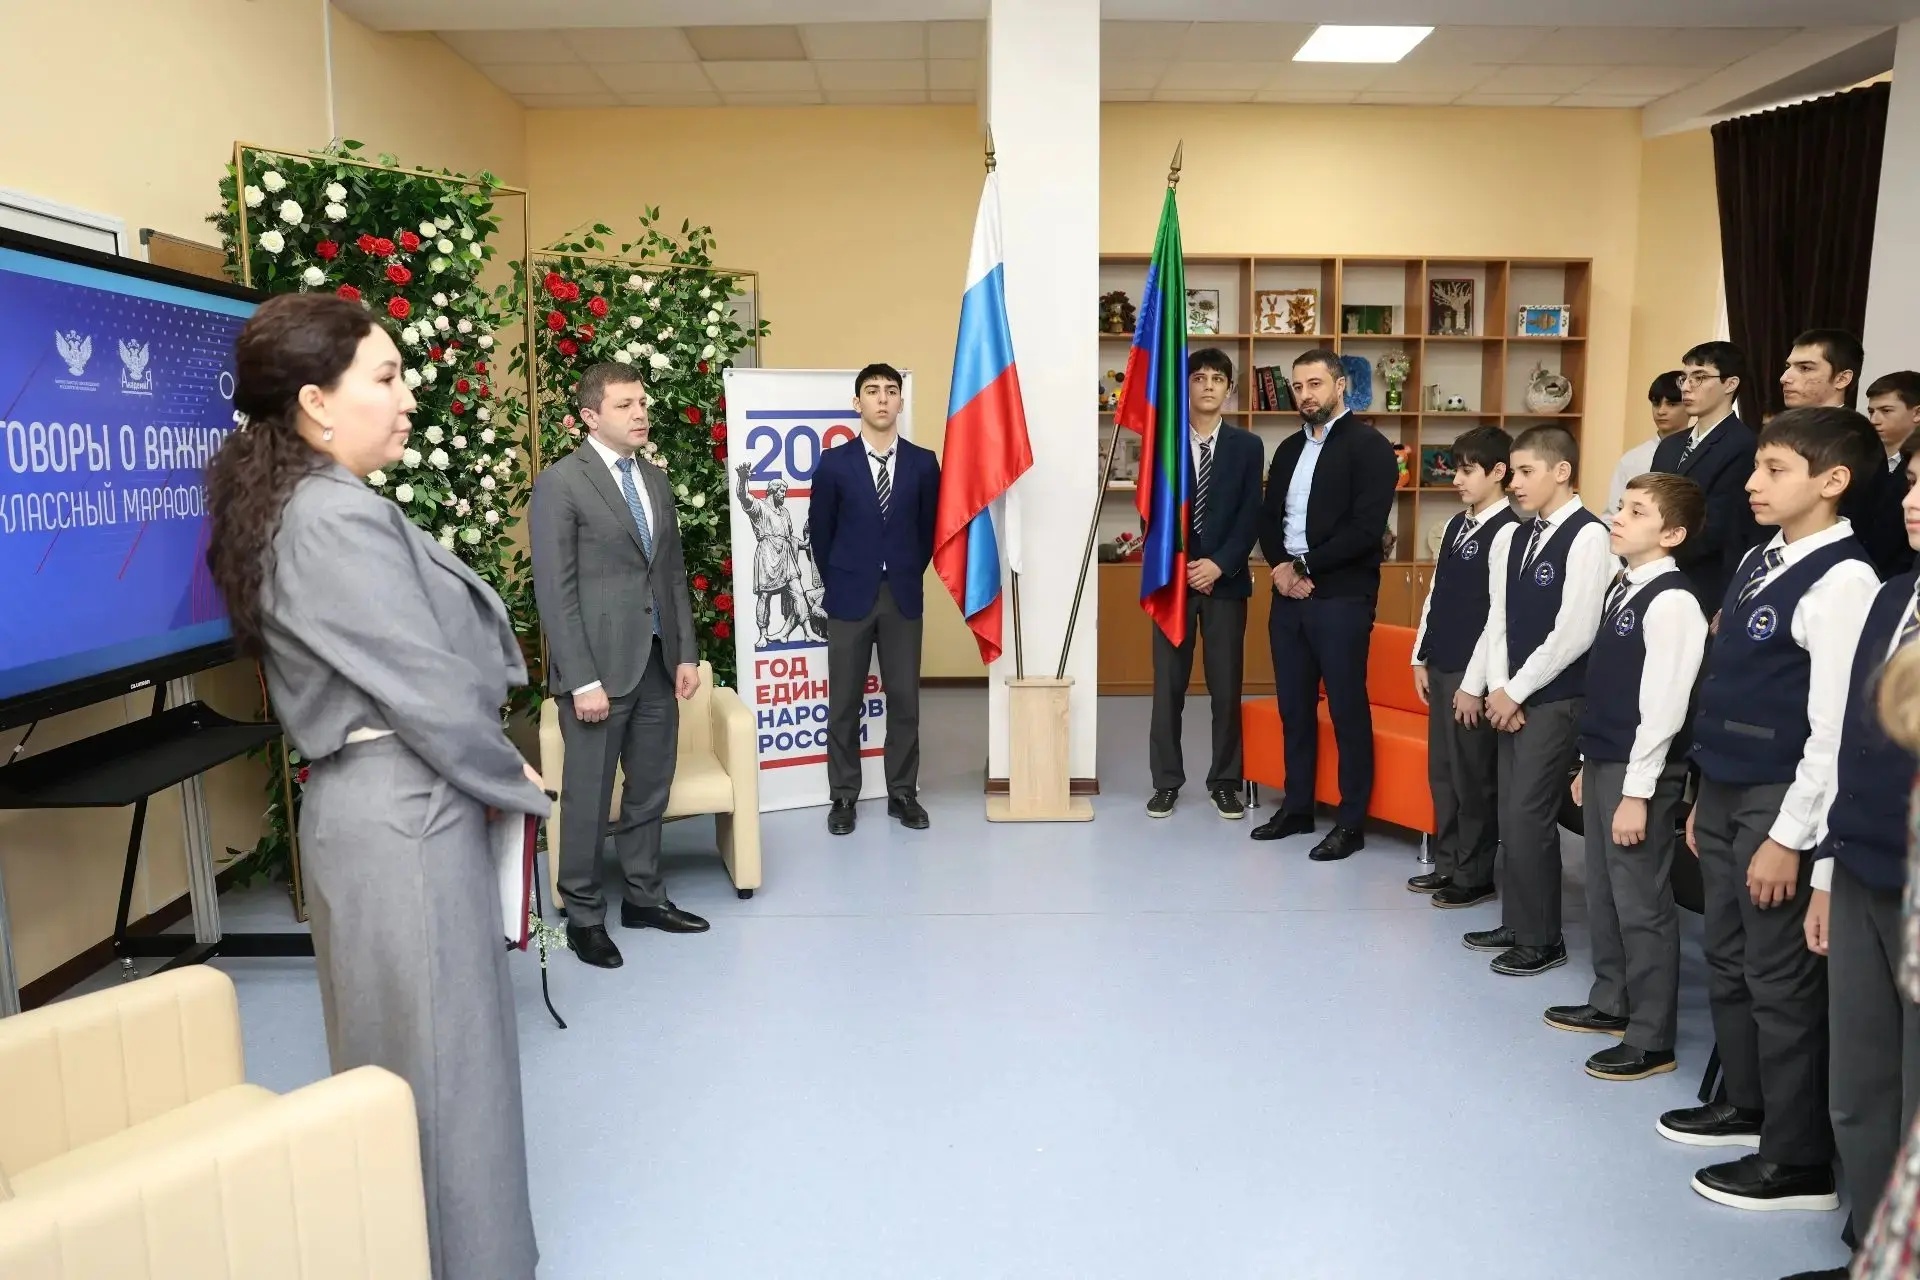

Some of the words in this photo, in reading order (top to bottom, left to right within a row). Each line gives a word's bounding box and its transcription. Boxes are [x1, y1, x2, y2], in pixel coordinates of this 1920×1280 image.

[119, 425, 136, 471] О
[145, 426, 236, 470] ВАЖНО
[746, 424, 856, 481] 20
[755, 656, 809, 680] ГОД
[756, 674, 886, 706] ЕДИНВ
[757, 699, 884, 729] НАРОВ
[758, 723, 868, 753] РОСС
